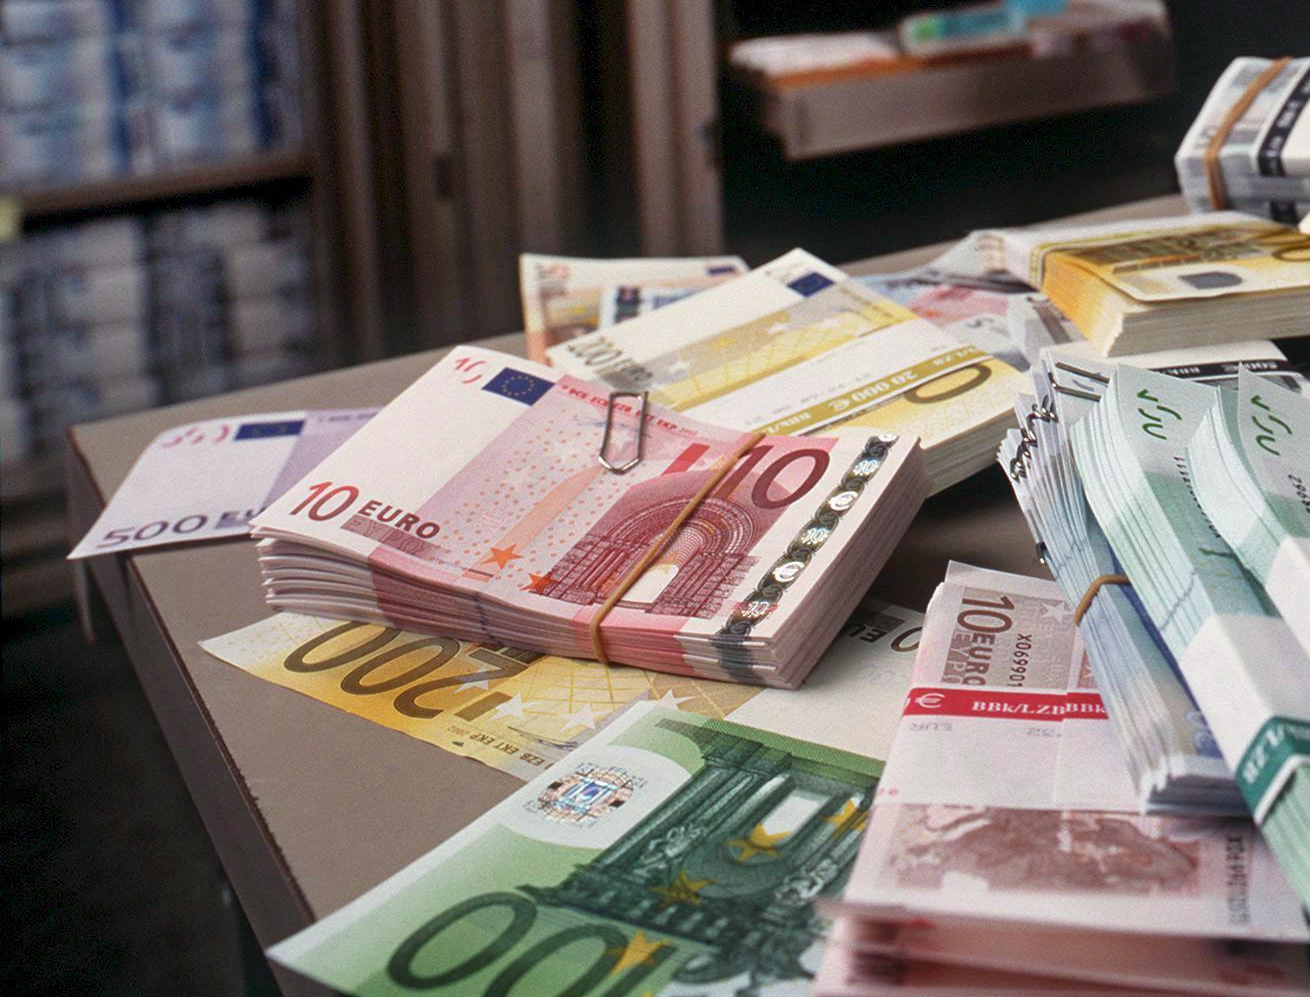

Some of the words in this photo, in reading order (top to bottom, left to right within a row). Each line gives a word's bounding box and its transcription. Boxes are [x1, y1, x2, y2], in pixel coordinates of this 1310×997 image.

[713, 443, 831, 510] 10
[97, 514, 208, 548] 500
[289, 480, 360, 522] 10
[358, 499, 442, 541] EURO
[957, 594, 1017, 635] 10
[284, 620, 529, 720] 200
